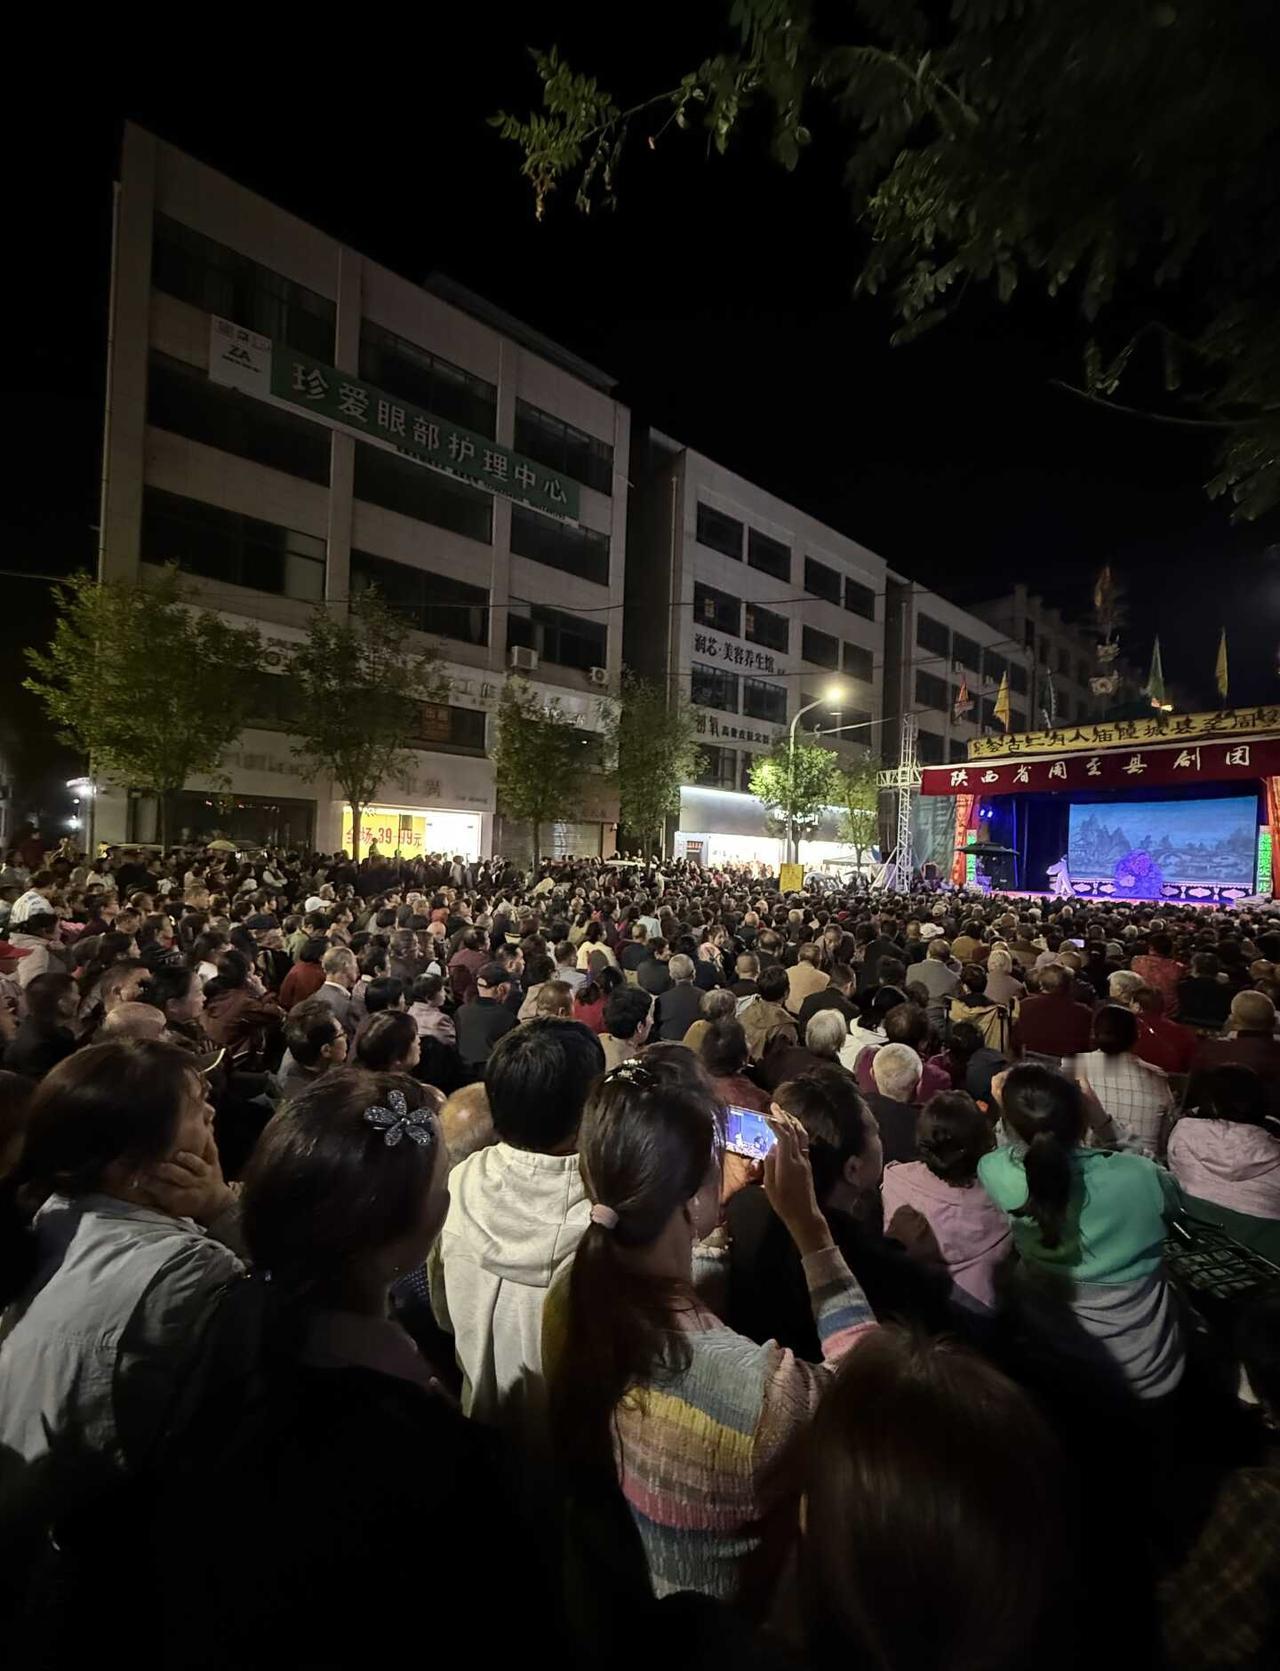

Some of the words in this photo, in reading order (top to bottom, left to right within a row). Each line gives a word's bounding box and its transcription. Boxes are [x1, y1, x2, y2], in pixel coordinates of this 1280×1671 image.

[291, 361, 568, 505] 珍爱眼部护理中心
[949, 745, 1251, 788] 陕西省周至县剧团
